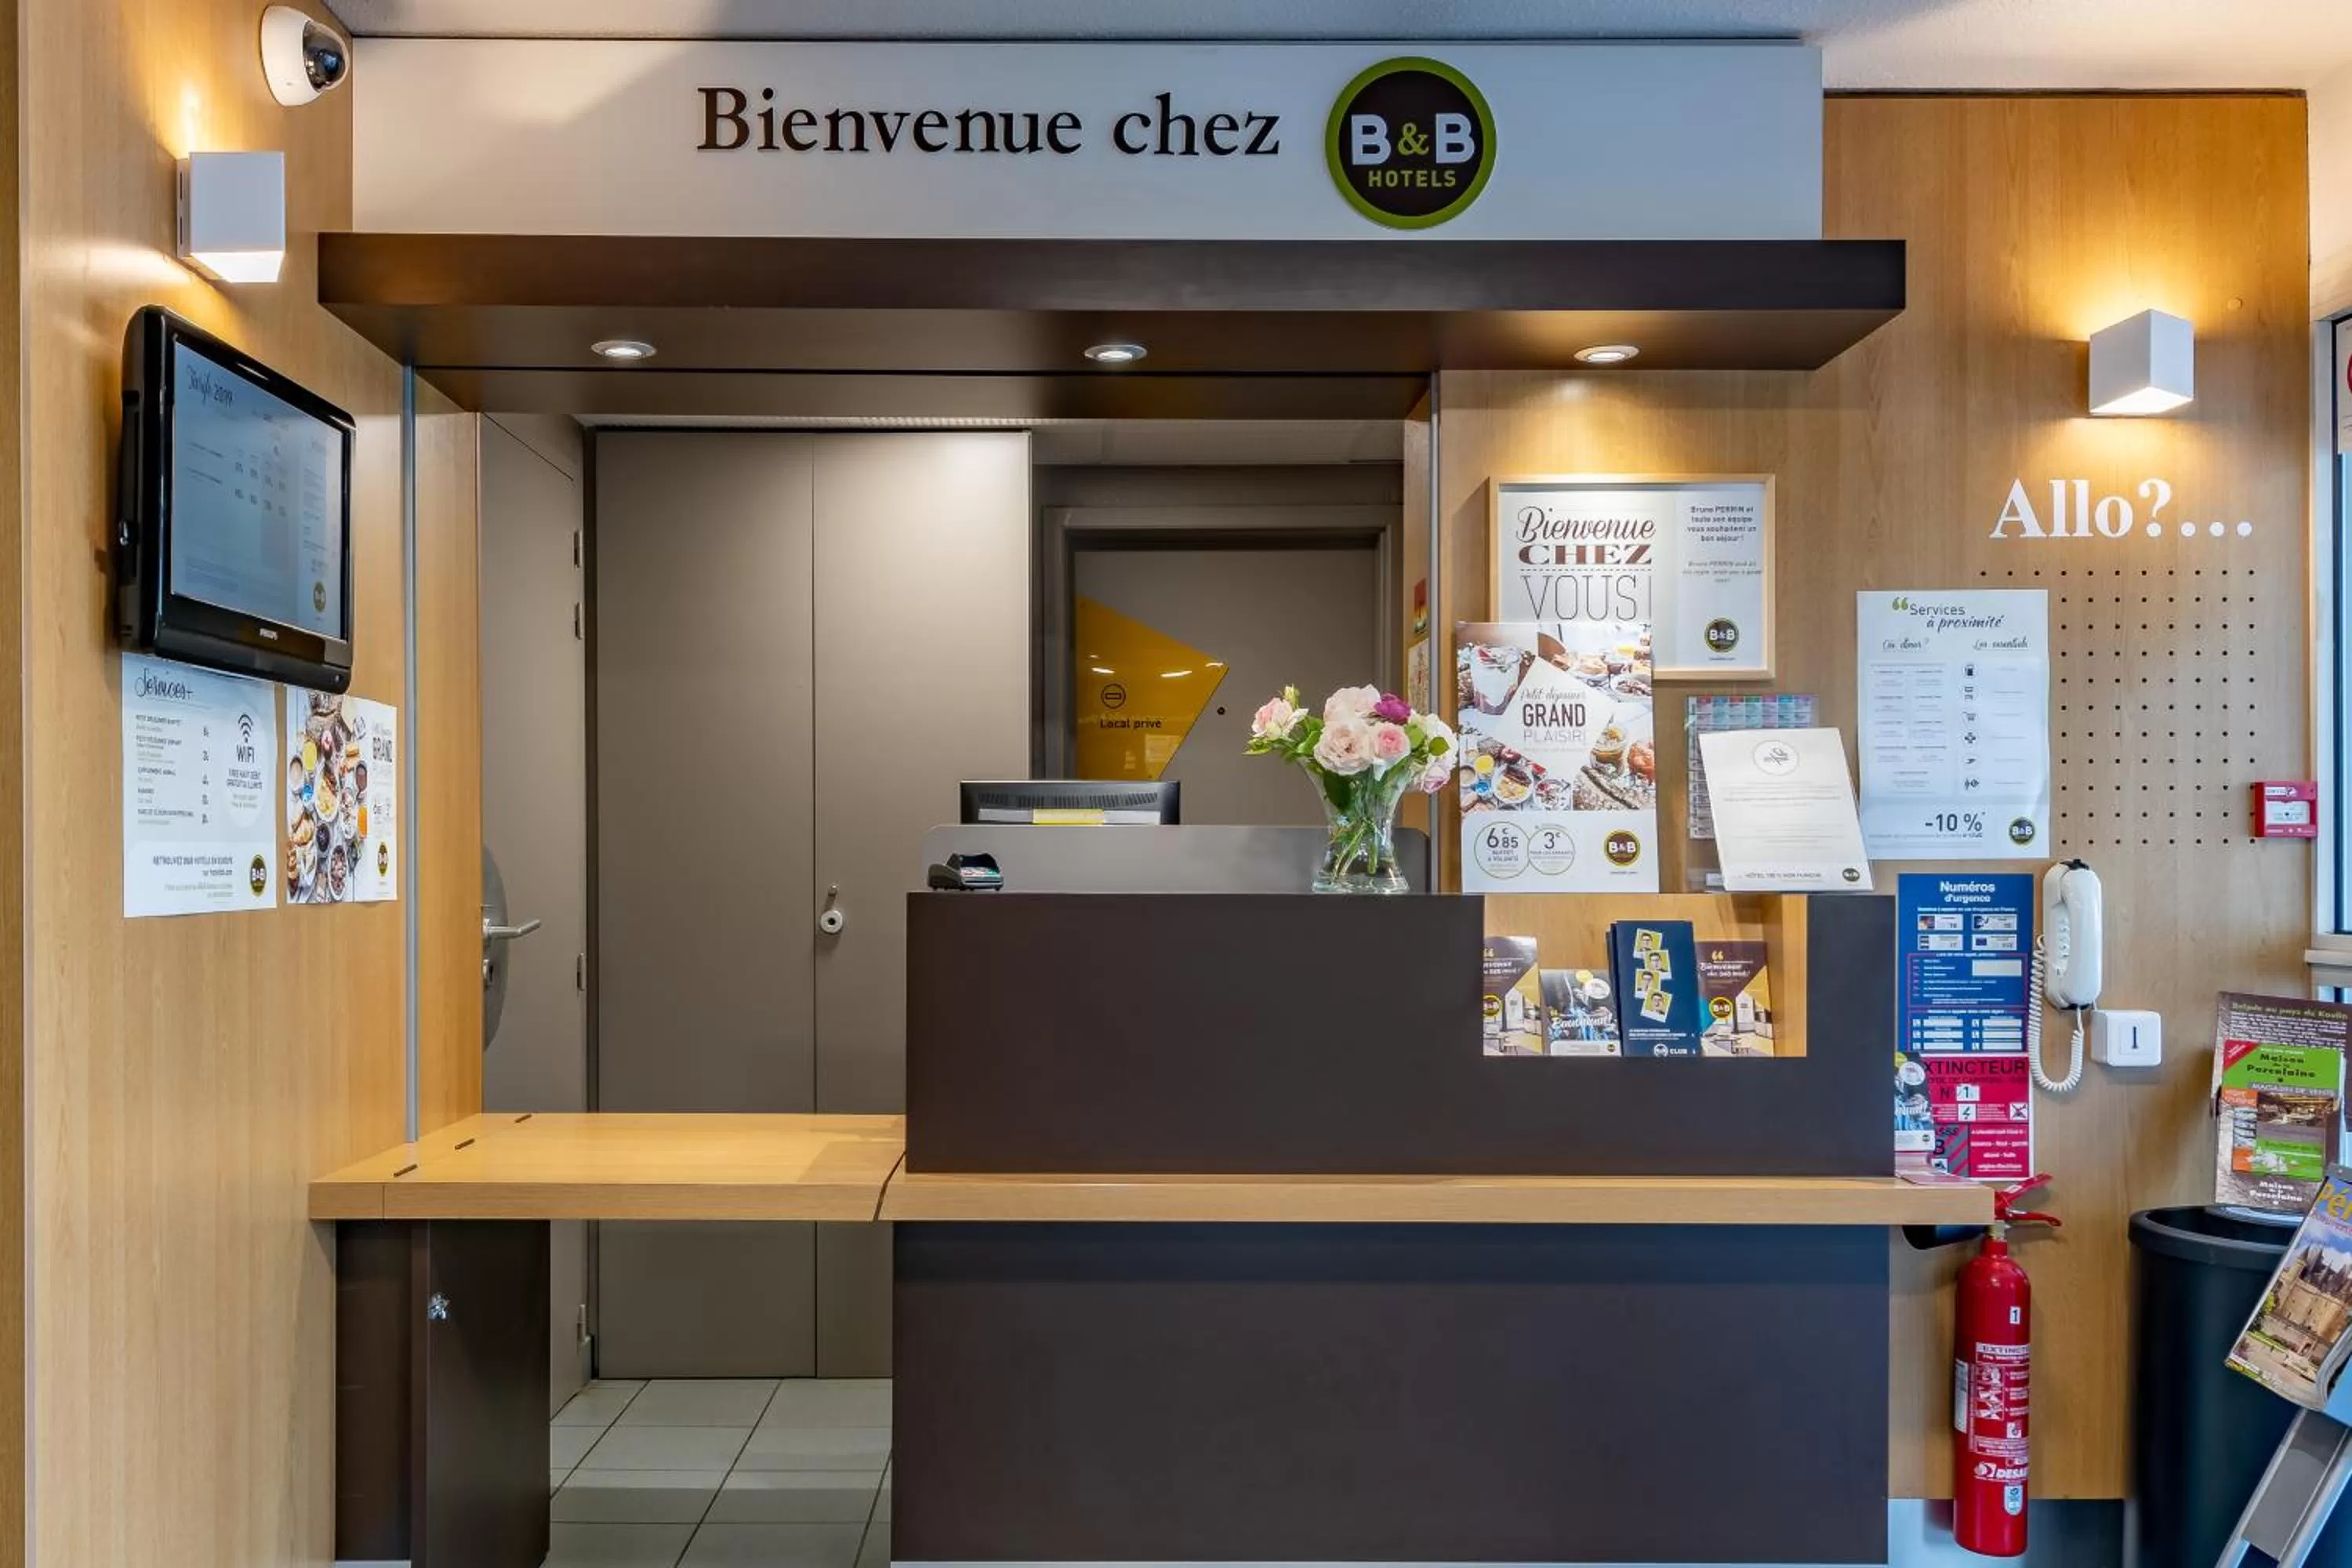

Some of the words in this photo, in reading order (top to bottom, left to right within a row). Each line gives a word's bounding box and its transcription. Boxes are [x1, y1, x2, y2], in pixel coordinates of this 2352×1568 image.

[697, 87, 1082, 154] Bienvenue
[1112, 92, 1280, 156] chez
[1351, 113, 1475, 165] B&B
[1368, 169, 1456, 187] HOTELS
[1515, 506, 1656, 543] Bienvenue
[1519, 544, 1652, 565] CHEZ
[1910, 603, 1966, 616] Services
[1926, 615, 1935, 628] à
[1936, 614, 2005, 634] proximité
[1523, 703, 1586, 728] GRAND
[1940, 881, 1995, 892] Numéros
[1944, 894, 1991, 903] d'urgence
[1923, 1059, 2026, 1075] XTINCTEUR
